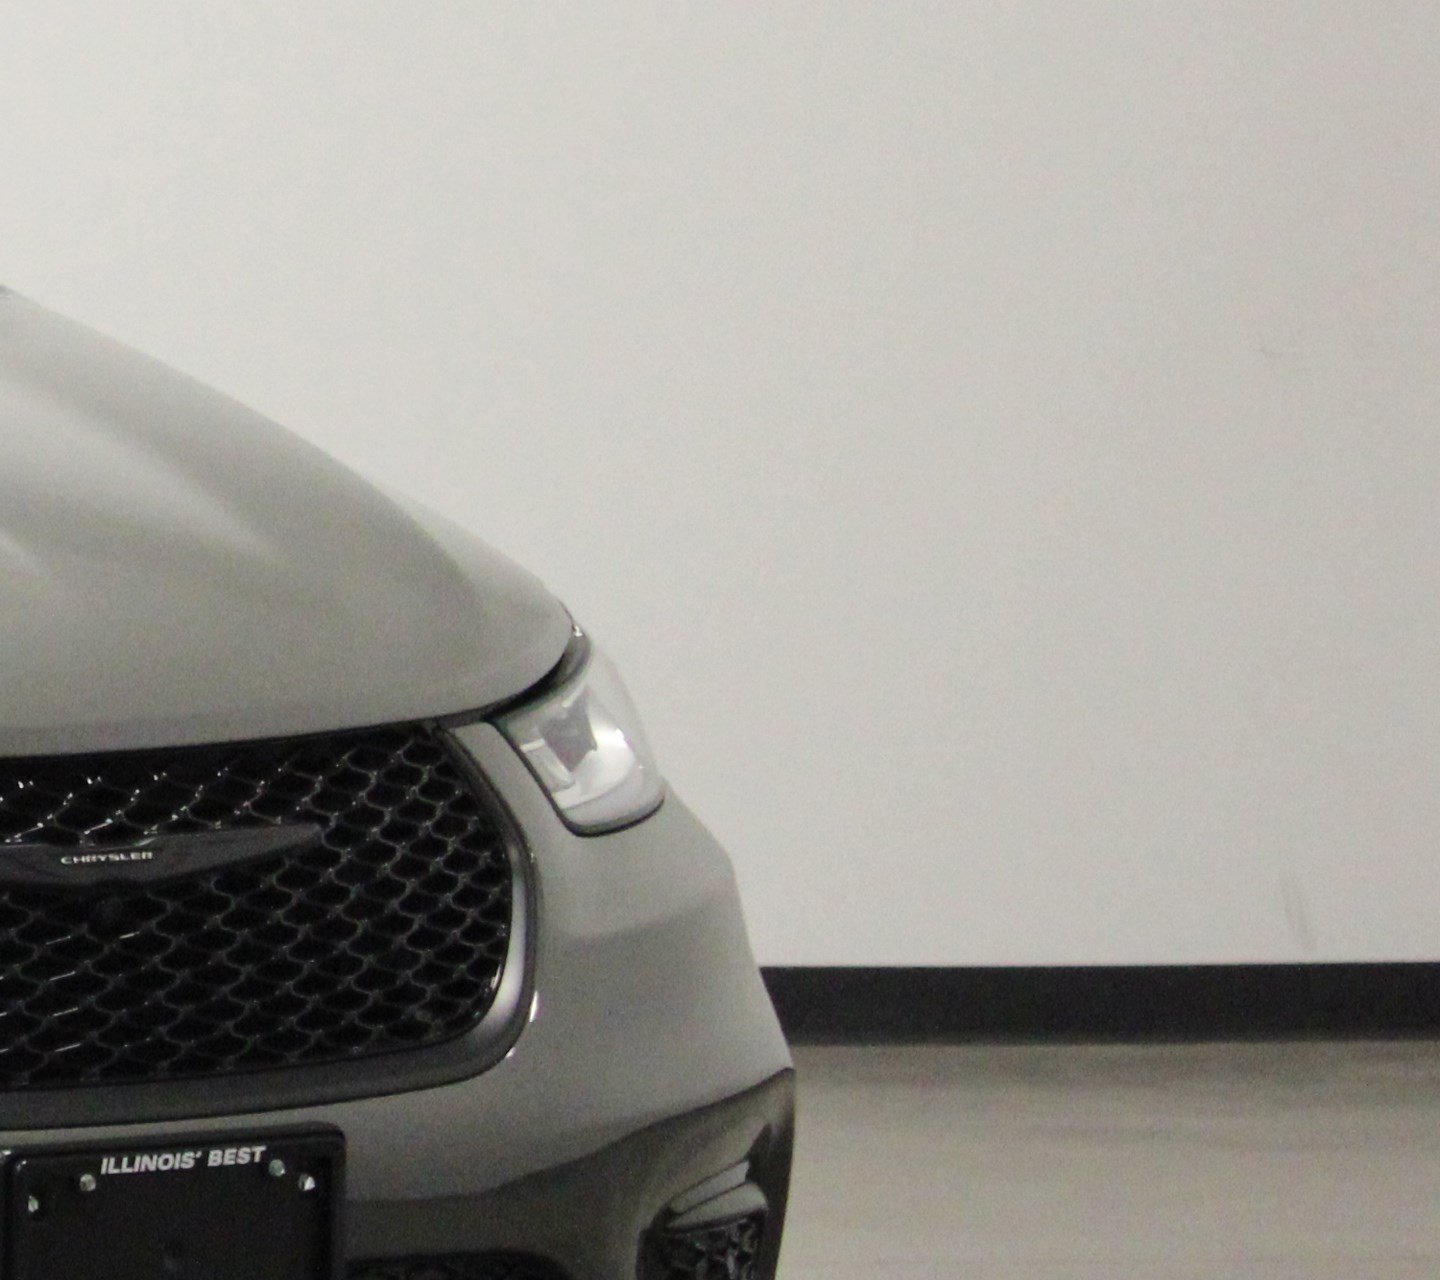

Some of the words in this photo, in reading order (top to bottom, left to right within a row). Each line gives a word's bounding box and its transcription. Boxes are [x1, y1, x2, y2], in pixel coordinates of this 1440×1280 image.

[60, 851, 154, 864] CHRYSLER
[100, 1150, 203, 1176] ILLINOIS'
[207, 1145, 267, 1169] BEST
